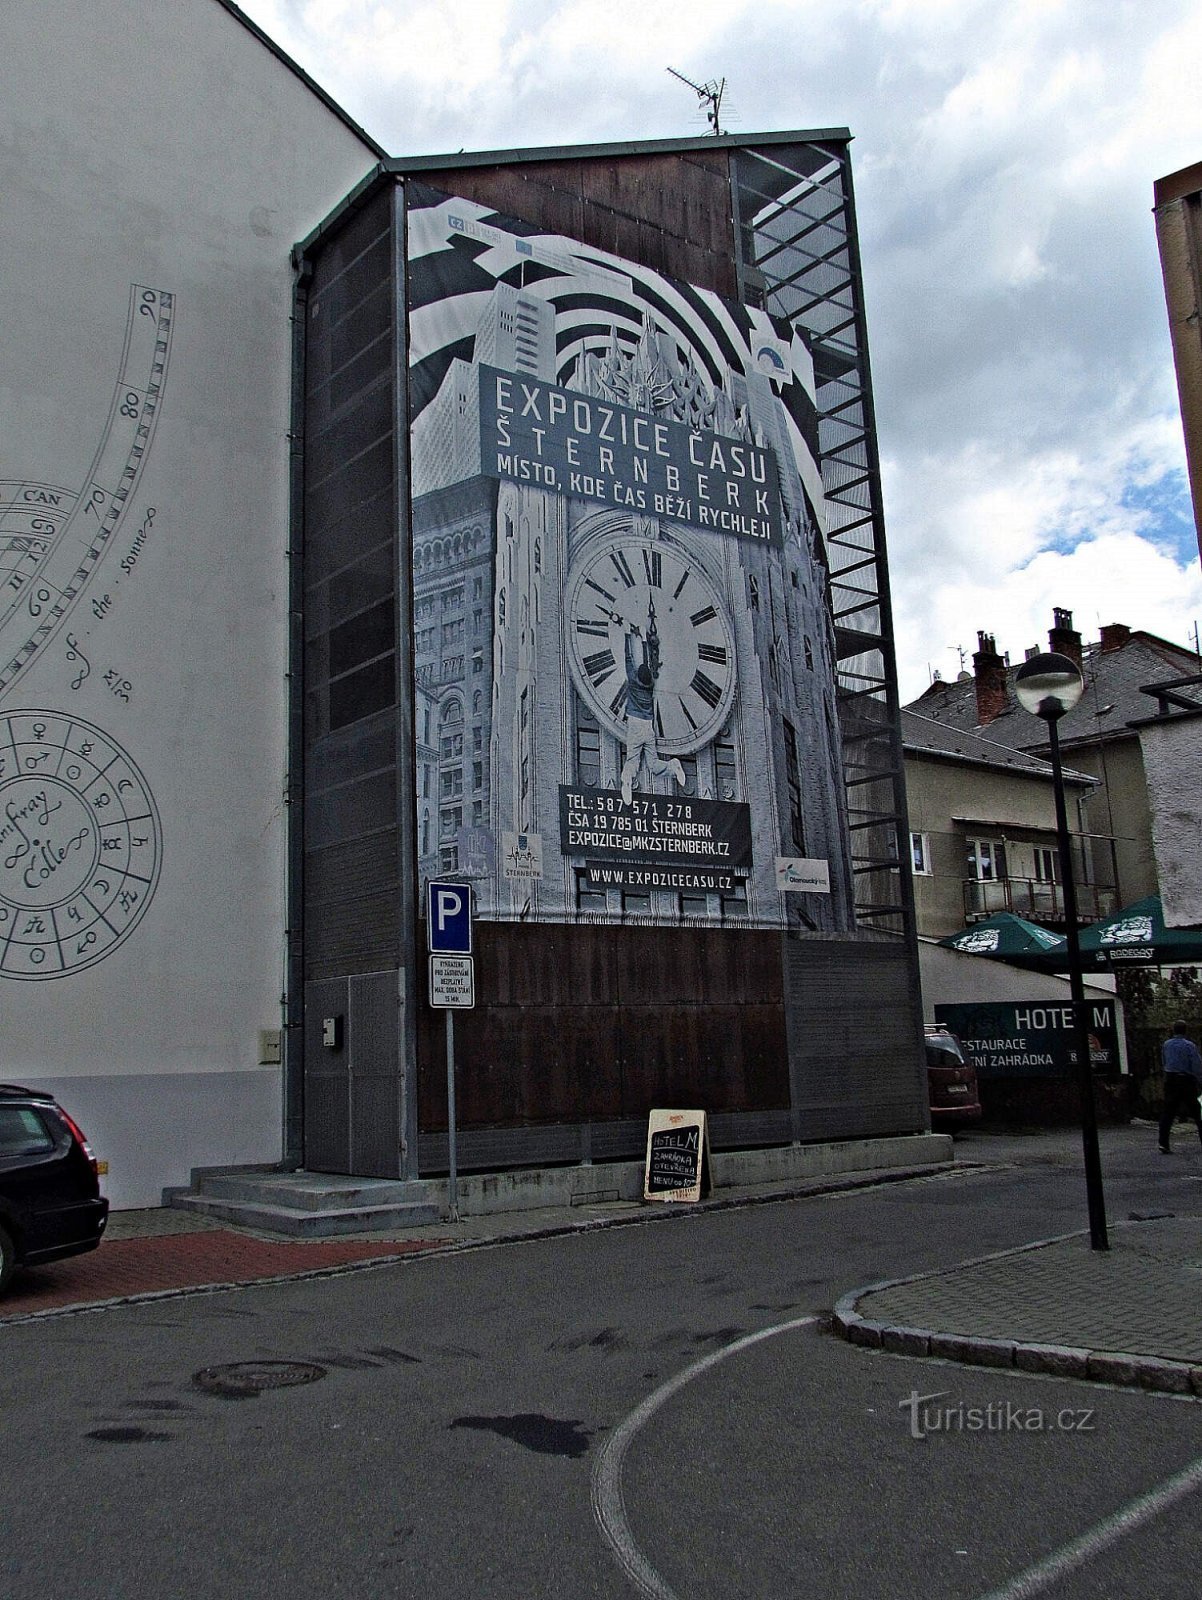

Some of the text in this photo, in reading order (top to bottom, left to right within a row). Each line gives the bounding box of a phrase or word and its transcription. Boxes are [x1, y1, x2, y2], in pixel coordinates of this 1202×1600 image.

[120, 392, 139, 419] 80
[496, 377, 766, 484] EXPOZICE ČASU
[497, 416, 769, 515] ŠTERNBERK
[24, 490, 62, 505] CAN
[83, 490, 105, 521] 70
[498, 453, 770, 540] MÍSTO, KDE ČAS BĚŽÍ RYCHLEJI
[28, 588, 51, 617] 60
[92, 593, 113, 620] the
[567, 794, 692, 819] TEL.: 587 571 278
[568, 811, 590, 828] ČSA
[593, 814, 607, 829] 19
[610, 816, 631, 831] 785
[652, 818, 713, 838] ŠTERNBERK
[569, 831, 730, 856] EXPOZICE@MKZSTERNBERK.CZ
[590, 868, 732, 889] WWW.EXPOZICECASU.CZ
[437, 890, 462, 931] P
[1015, 1007, 1111, 1030] HOTE M
[990, 1053, 1054, 1067] ZAHRÁDKA
